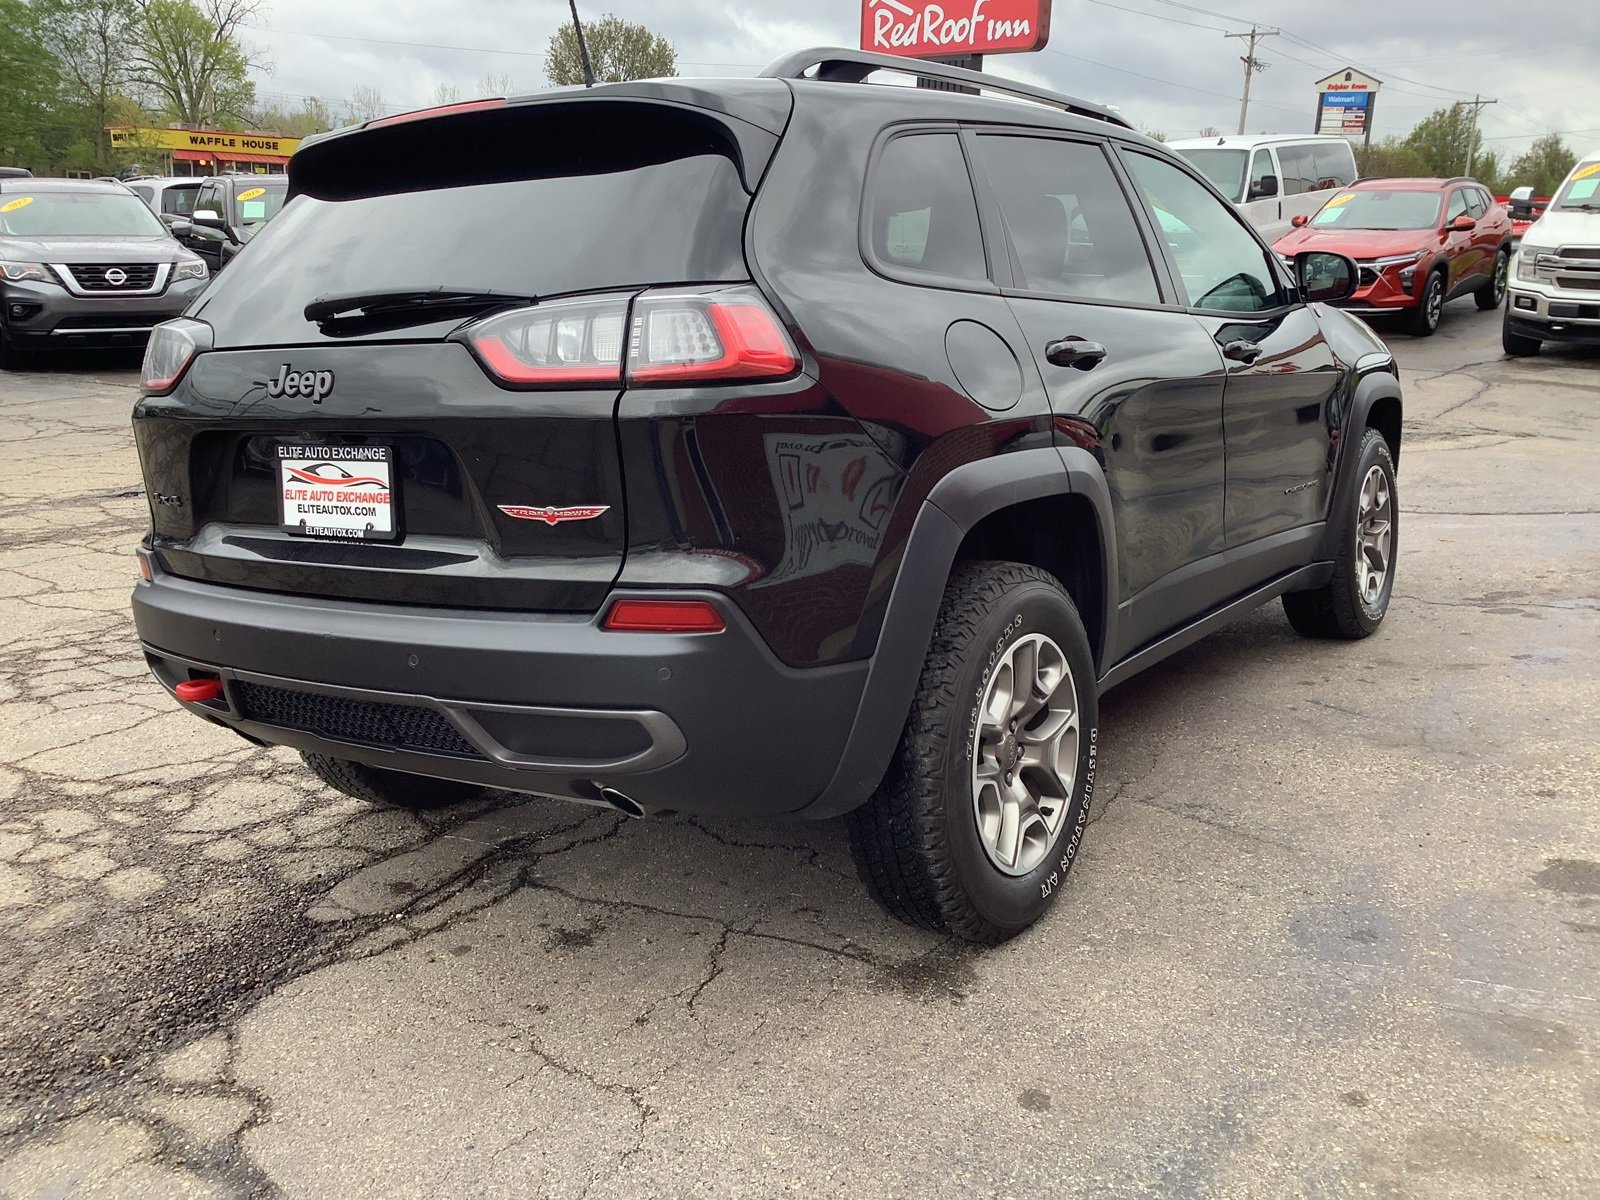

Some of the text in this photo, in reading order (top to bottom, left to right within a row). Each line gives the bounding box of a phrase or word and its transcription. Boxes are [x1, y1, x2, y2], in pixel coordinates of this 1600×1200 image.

[987, 18, 1030, 42] inn
[189, 135, 279, 150] WAFFLE HOUSE
[268, 364, 334, 404] Jeep
[278, 446, 386, 460] ELITE AUTO EXCHANGE
[284, 489, 391, 504] ELITE AUTO EXCHANGE
[297, 503, 377, 517] ELITEAUTOX.COM
[305, 526, 365, 538] ELITEAUTOX.COM
